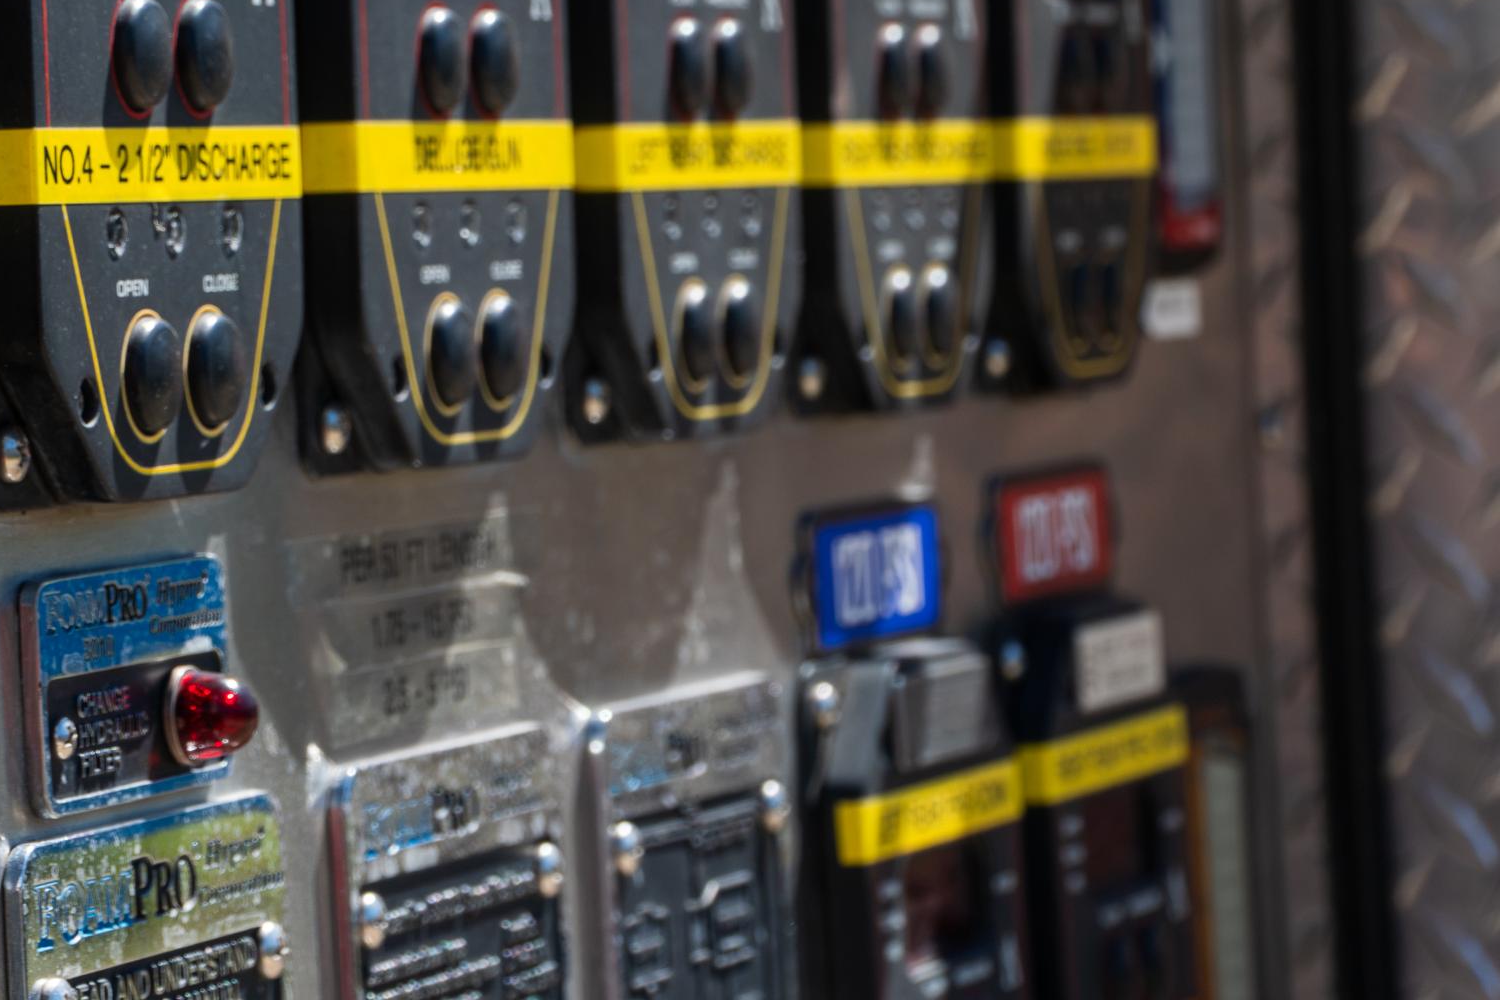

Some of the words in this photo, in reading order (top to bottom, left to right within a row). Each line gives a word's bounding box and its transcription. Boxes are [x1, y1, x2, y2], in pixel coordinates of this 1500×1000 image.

[43, 145, 93, 185] NO.4
[178, 143, 292, 182] DISCHARGE
[117, 279, 149, 297] OPEN
[203, 274, 239, 293] CLOSE
[77, 686, 131, 718] CHANGE
